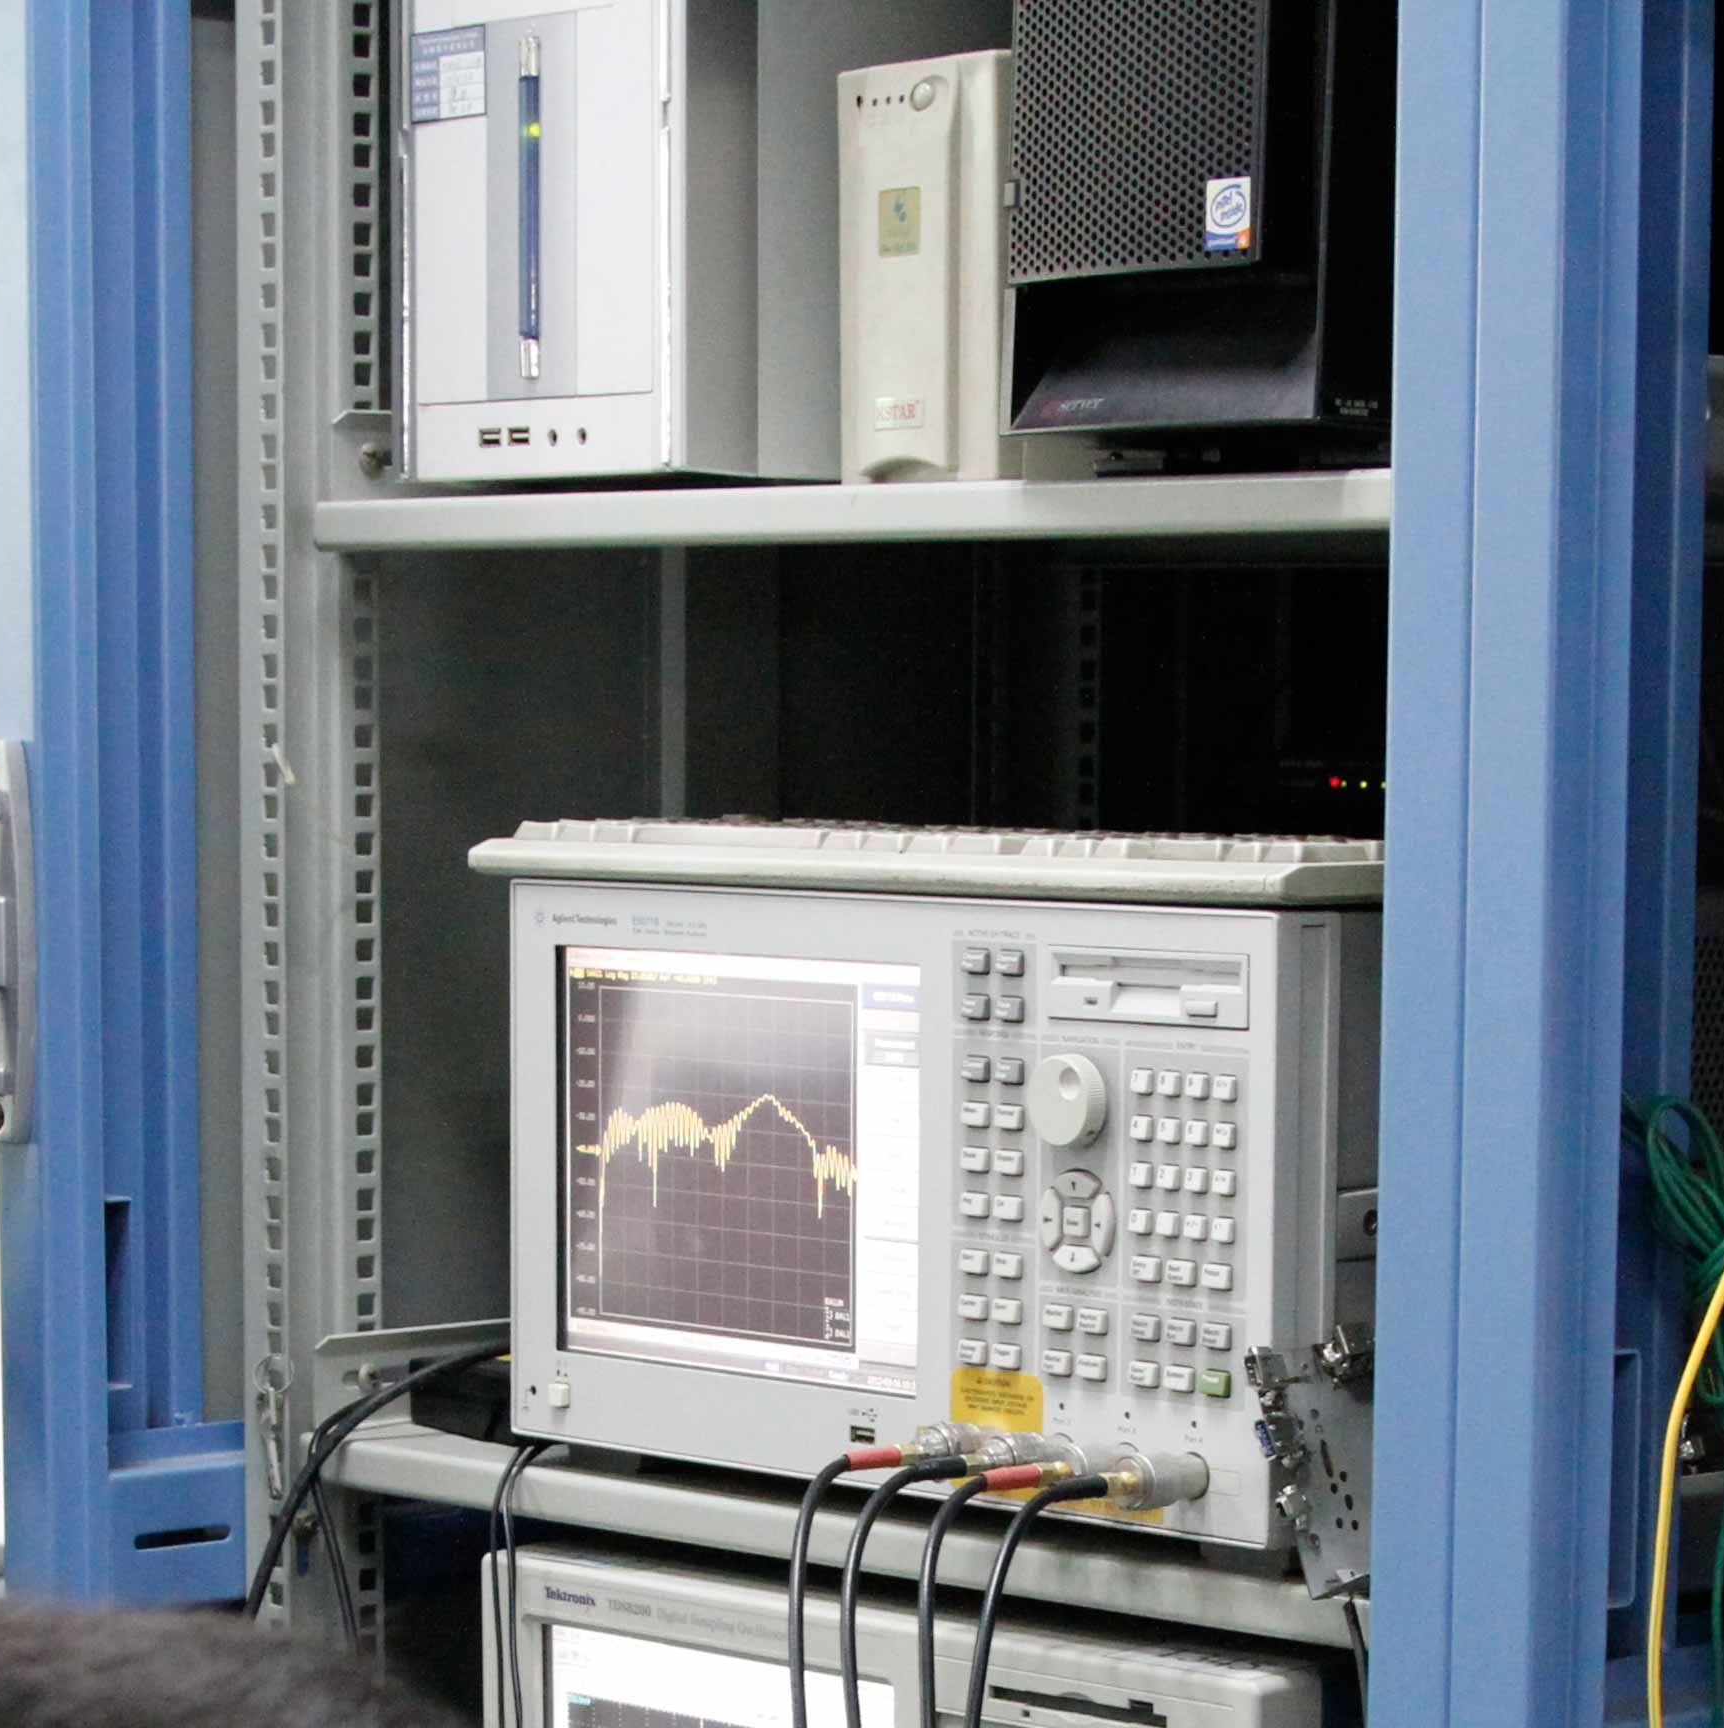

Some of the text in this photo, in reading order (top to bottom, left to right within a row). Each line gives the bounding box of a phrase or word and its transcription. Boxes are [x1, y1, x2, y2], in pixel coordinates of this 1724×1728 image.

[552, 911, 575, 925] Agilent
[575, 912, 618, 926] Technologies
[545, 1585, 597, 1608] Tektronix
[657, 1607, 686, 1625] Digital
[690, 1612, 735, 1636] Sampling
